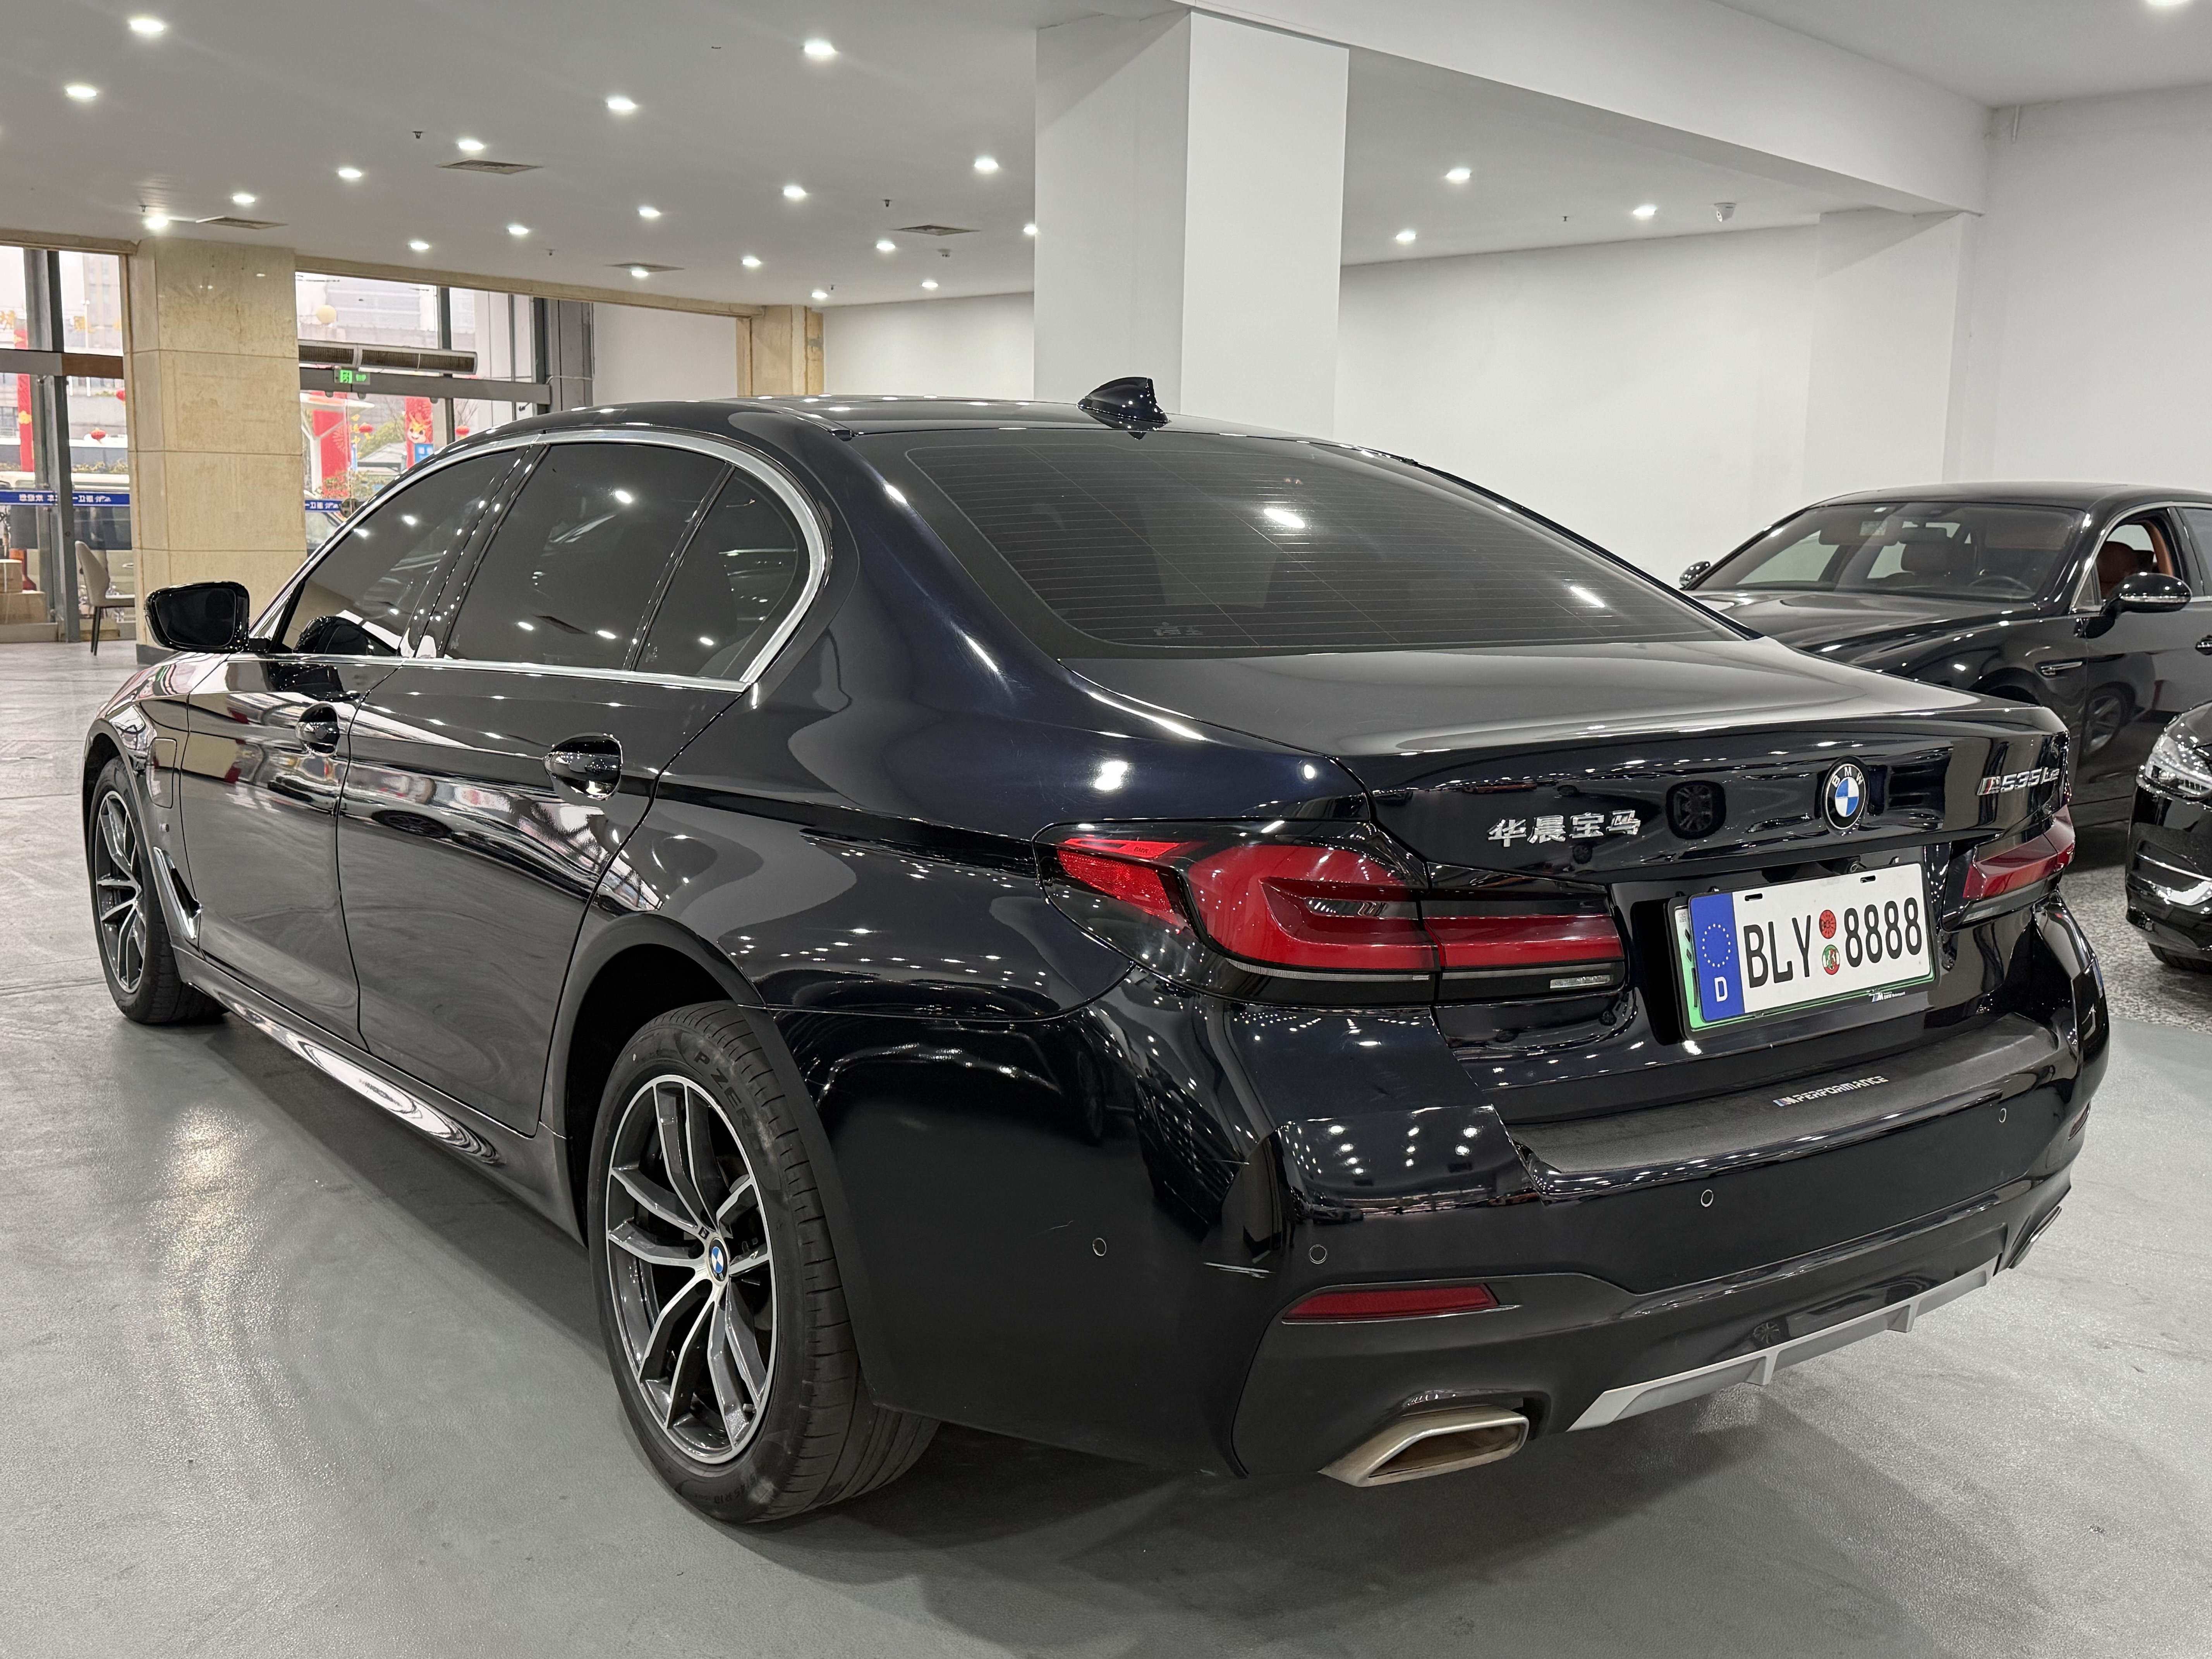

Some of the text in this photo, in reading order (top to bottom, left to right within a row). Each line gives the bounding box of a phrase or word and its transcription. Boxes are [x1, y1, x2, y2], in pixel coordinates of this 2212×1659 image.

[1832, 766, 1863, 787] BMW
[1487, 810, 1641, 847] 华晨宝马
[1743, 897, 1922, 988] BLY 8888
[1714, 976, 1728, 1002] D
[694, 1051, 710, 1066] P
[1793, 1076, 1889, 1102] PERFORMANCE
